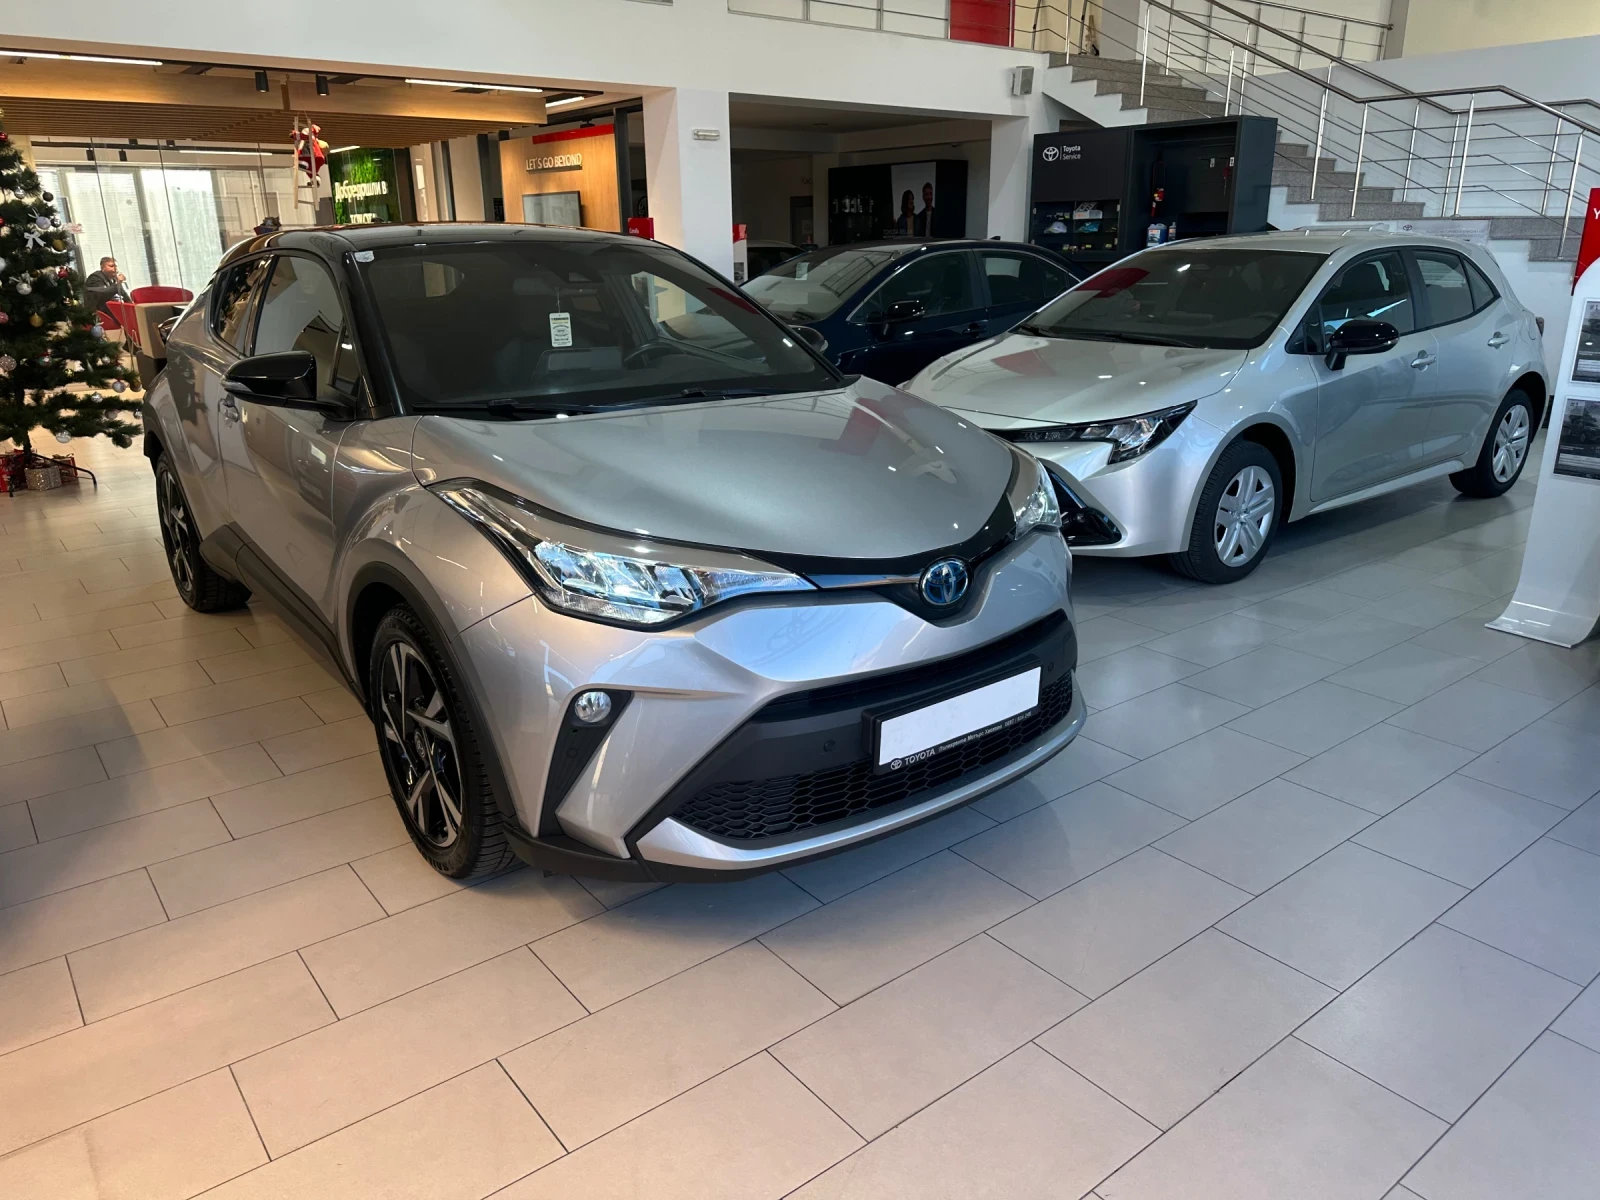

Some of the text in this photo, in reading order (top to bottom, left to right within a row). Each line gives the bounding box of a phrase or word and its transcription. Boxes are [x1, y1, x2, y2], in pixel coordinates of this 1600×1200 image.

[1063, 145, 1081, 153] Toyota
[543, 157, 554, 169] GO
[554, 153, 582, 168] BEYOND
[904, 748, 936, 765] TOYOTA
